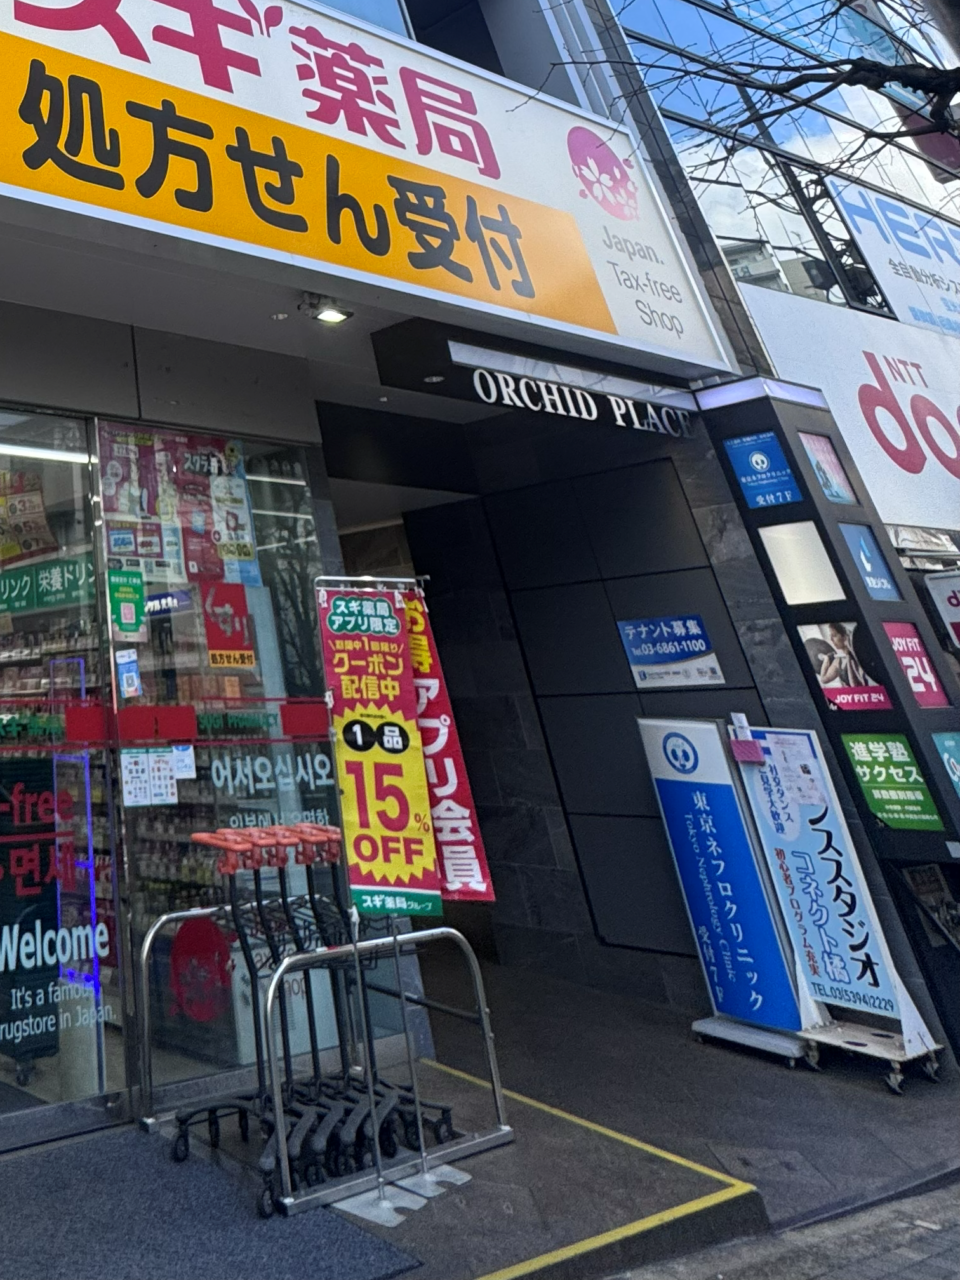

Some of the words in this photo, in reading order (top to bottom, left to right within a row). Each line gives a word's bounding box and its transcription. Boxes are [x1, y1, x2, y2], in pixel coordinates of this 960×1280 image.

[17, 58, 537, 300] 処方せん受付
[602, 224, 667, 267] Japan.
[606, 260, 684, 305] Tax-free
[638, 300, 685, 340] Shop
[882, 353, 929, 389] NTT
[472, 368, 600, 423] ORCHID
[610, 395, 693, 441] PLACE
[335, 600, 390, 616] スギ薬局
[330, 614, 398, 634] アプリ限定
[624, 618, 703, 640] テナント募集
[891, 637, 908, 652] JOY
[906, 637, 921, 652] FIT
[210, 652, 254, 666] 処方せん受付
[332, 652, 404, 676] クーポン
[901, 656, 938, 692] 24
[340, 674, 401, 702] 配信中
[835, 693, 853, 704] JOY
[854, 692, 869, 703] FIT
[870, 692, 885, 702] 24
[849, 741, 911, 762] 進学塾
[211, 752, 336, 796] 어서오십시오
[855, 765, 924, 783] サクセス
[352, 833, 425, 866] OFF
[692, 788, 764, 1012] 東京ネフロクリニック
[35, 994, 45, 1006] a
[59, 1011, 73, 1030] in
